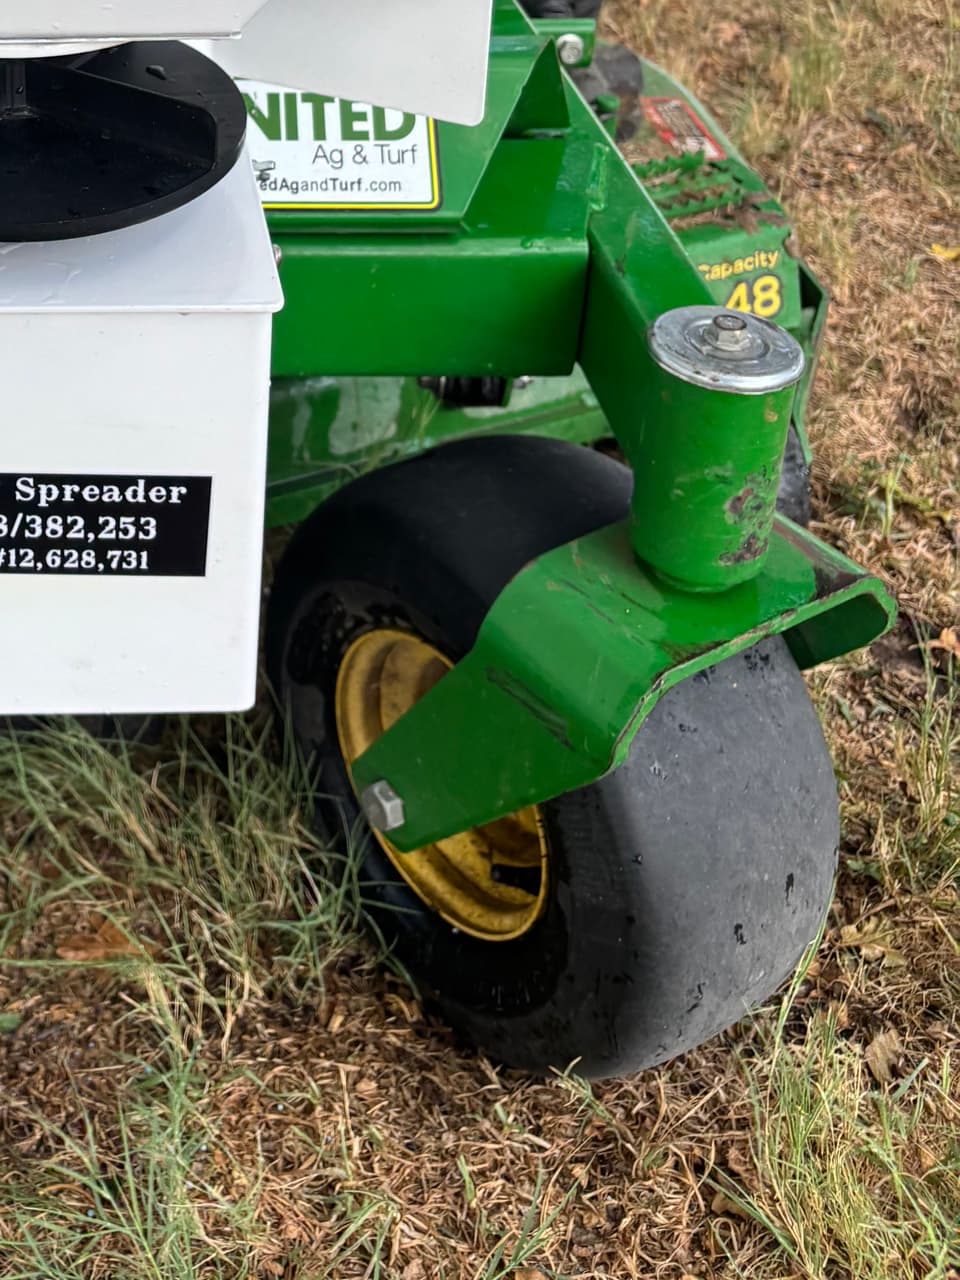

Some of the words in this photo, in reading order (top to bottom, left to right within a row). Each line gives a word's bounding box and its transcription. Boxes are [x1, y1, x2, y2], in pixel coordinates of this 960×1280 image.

[311, 143, 344, 170] Ag
[352, 143, 368, 165] &
[374, 143, 418, 165] Turf
[723, 274, 782, 318] 48
[14, 475, 188, 508] Spreader
